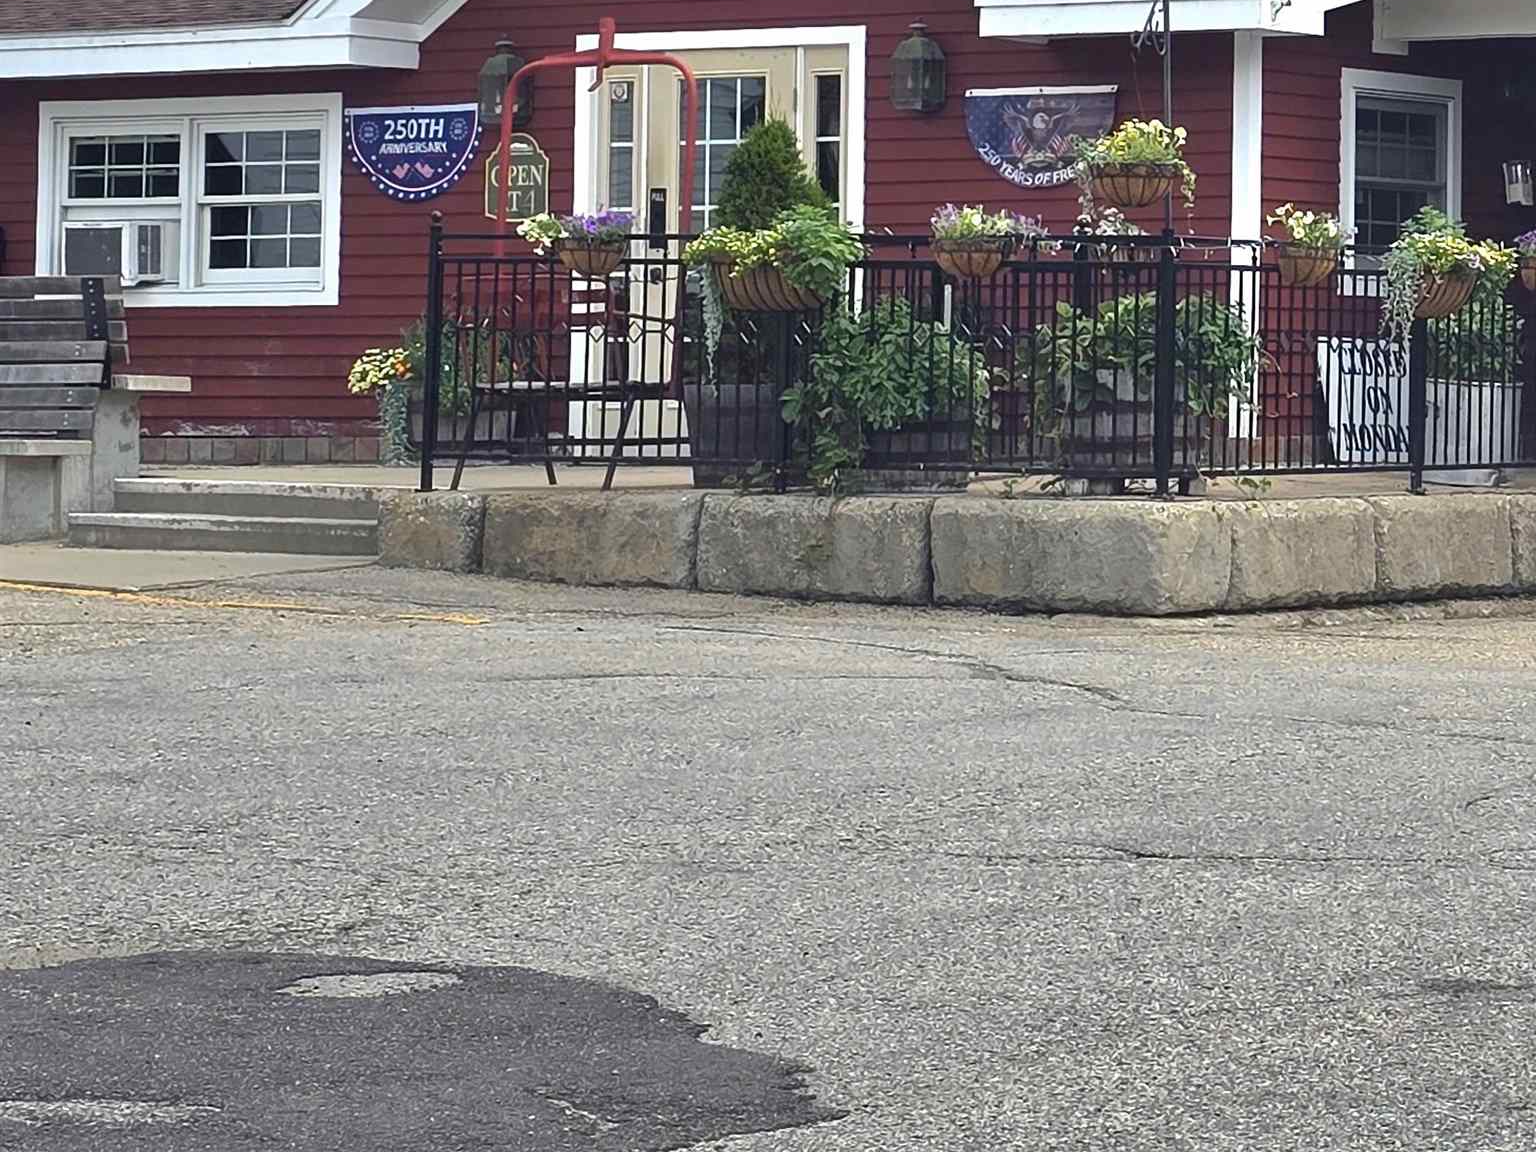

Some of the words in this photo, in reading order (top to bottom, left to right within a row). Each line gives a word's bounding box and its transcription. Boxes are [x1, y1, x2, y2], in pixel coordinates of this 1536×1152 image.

[383, 118, 445, 140] 250TH
[378, 141, 448, 155] ANNIVERSARY
[977, 142, 1001, 166] 250
[999, 160, 1033, 186] YEARS
[1034, 171, 1052, 185] OF
